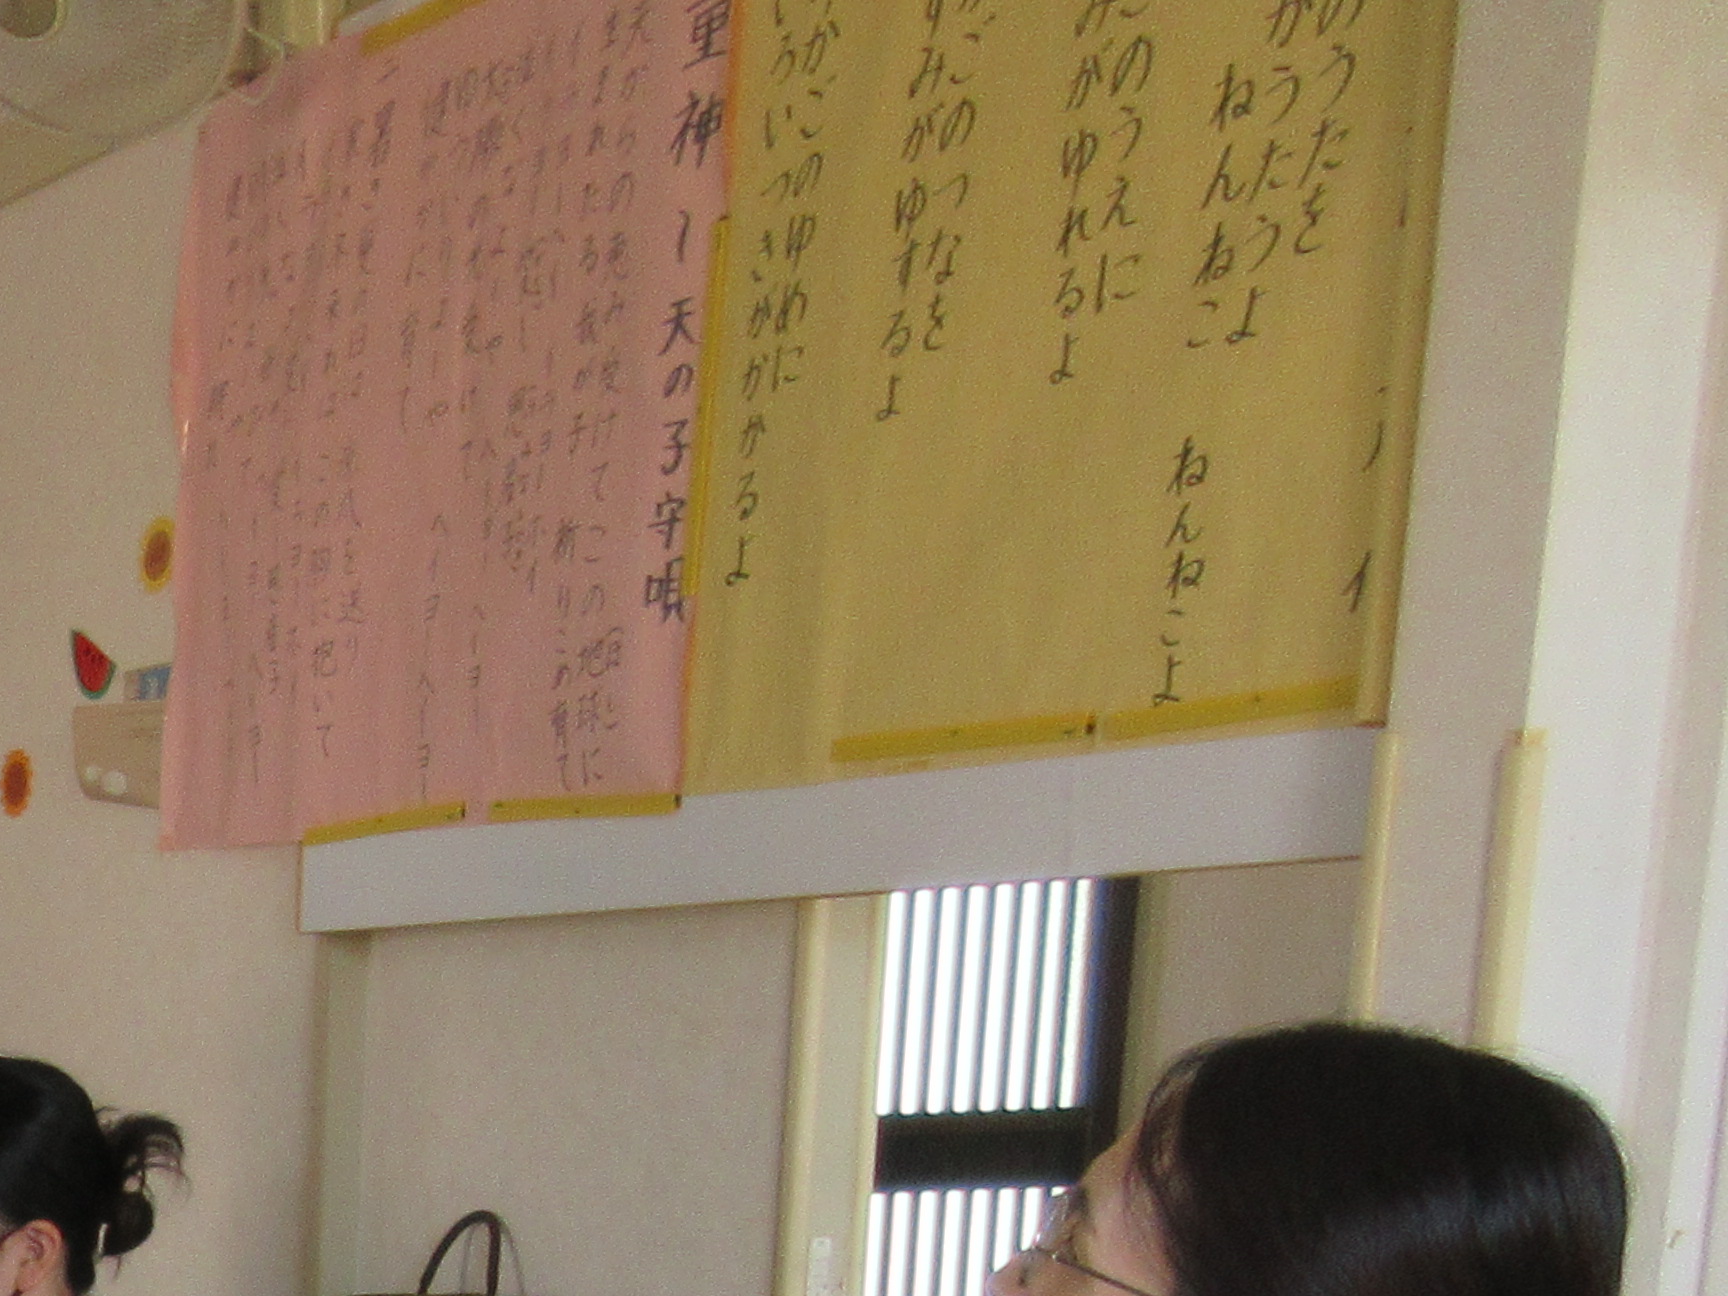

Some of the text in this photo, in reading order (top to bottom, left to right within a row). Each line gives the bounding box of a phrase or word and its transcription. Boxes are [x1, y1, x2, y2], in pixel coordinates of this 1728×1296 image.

[924, 0, 996, 351] ごのつなを
[1096, 0, 1152, 315] のうえに
[1151, 62, 1255, 708] ねんねこ ねんねこよ
